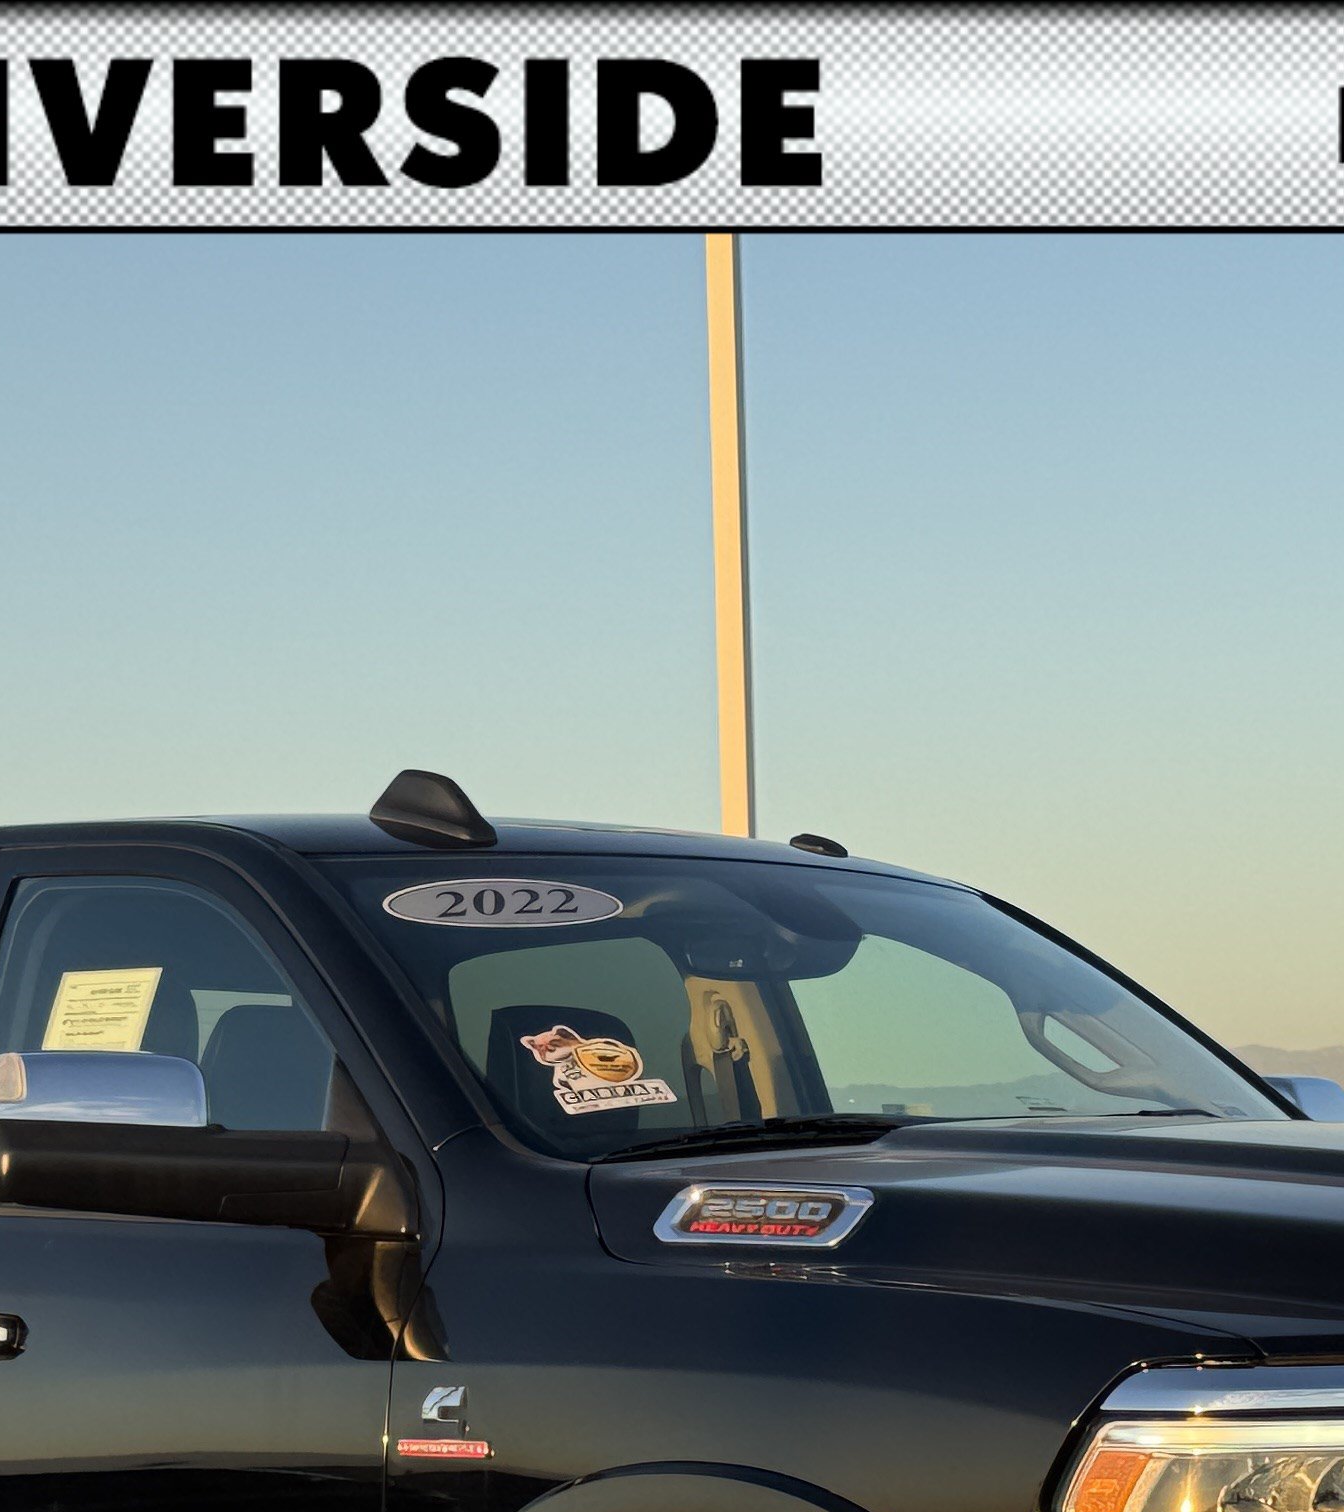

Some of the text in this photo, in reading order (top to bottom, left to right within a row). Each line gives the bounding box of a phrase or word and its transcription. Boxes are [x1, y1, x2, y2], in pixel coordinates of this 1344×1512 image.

[435, 888, 579, 918] 2022
[700, 1198, 832, 1221] 2500
[689, 1221, 820, 1237] HEAVY DUTY
